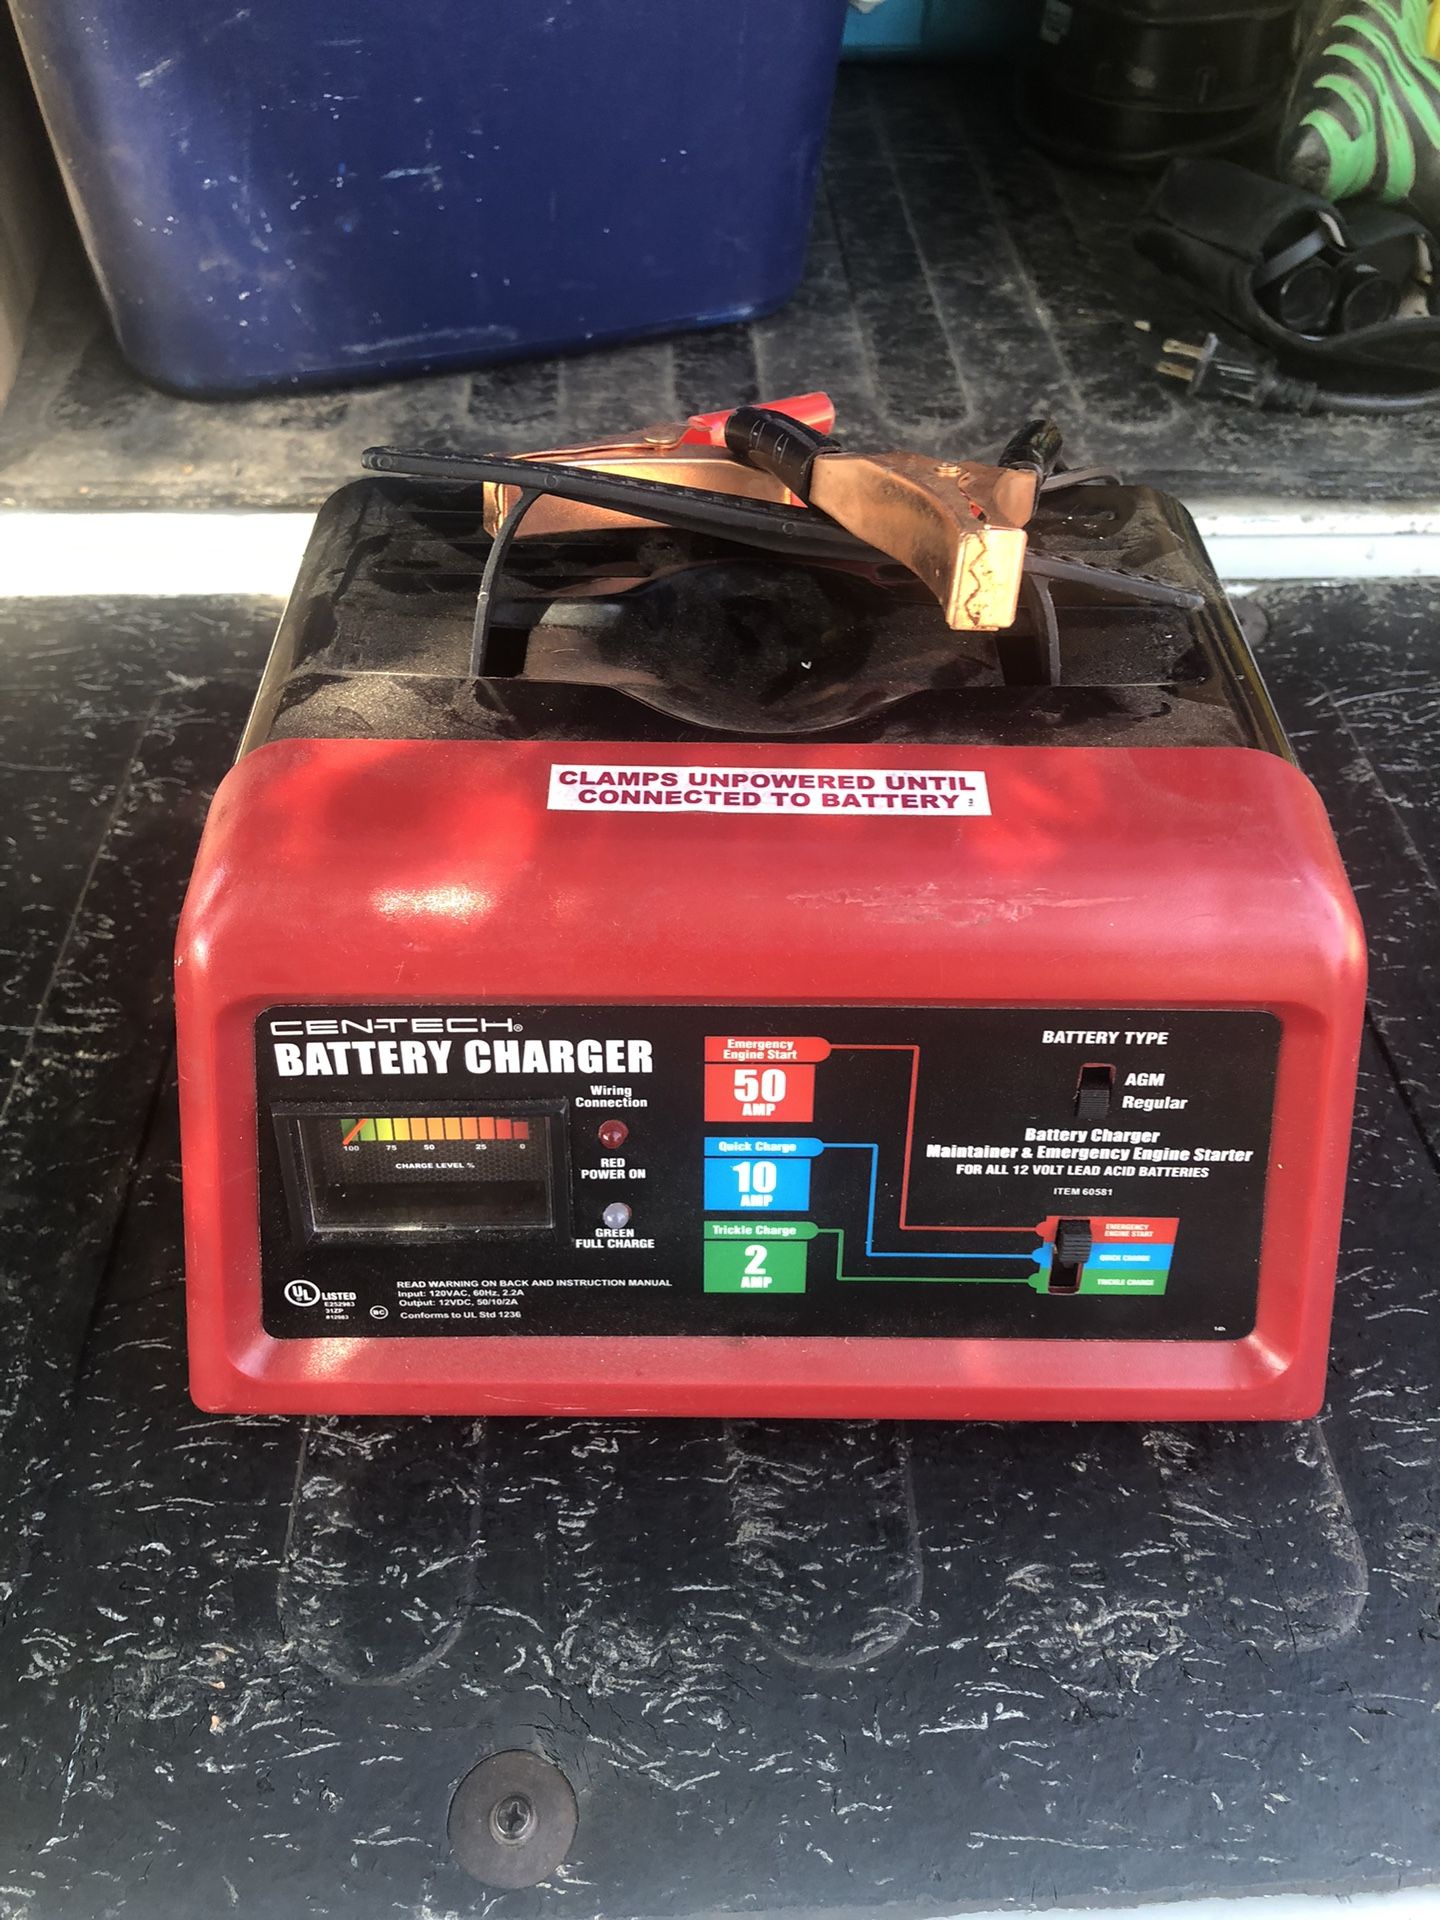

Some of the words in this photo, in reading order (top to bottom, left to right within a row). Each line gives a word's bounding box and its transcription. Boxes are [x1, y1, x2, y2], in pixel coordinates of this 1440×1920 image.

[558, 770, 678, 787] CLAMPS
[688, 772, 876, 790] UNPOWERED
[885, 775, 976, 791] UNTIL
[577, 789, 761, 806] CONNECTED
[769, 791, 811, 807] TO
[821, 793, 960, 809] BATTERY
[1042, 1030, 1120, 1044] BATTERY
[1124, 1032, 1169, 1045] TYPE
[727, 1039, 795, 1050] Emergency
[273, 1040, 453, 1077] BATTERY
[464, 1039, 654, 1075] CHARGER
[723, 1049, 764, 1061] Engine
[767, 1049, 798, 1060] Start
[733, 1068, 787, 1103] 50
[1124, 1073, 1165, 1086] AGM
[590, 1085, 632, 1097] Wiring
[575, 1097, 648, 1108] Connection
[1121, 1095, 1188, 1112] Regular
[742, 1103, 776, 1116] AMP
[1024, 1128, 1087, 1143] Battery
[1090, 1129, 1160, 1145] Charger
[718, 1141, 753, 1152] Quick
[755, 1141, 797, 1153] Charge
[926, 1144, 1019, 1159] Maintainer
[1021, 1147, 1034, 1159] &
[1036, 1146, 1130, 1162] Emergency
[1133, 1147, 1190, 1163] Engine
[1193, 1148, 1254, 1163] Starter
[600, 1158, 626, 1168] RED
[580, 1169, 626, 1180] POWER
[629, 1169, 646, 1179] ON
[731, 1161, 777, 1193] 10
[956, 1164, 983, 1175] FOR
[985, 1164, 1009, 1175] ALL
[1012, 1165, 1030, 1175] 12
[1032, 1165, 1064, 1176] VOLT
[1066, 1165, 1101, 1177] LEAD
[1103, 1166, 1136, 1177] ACID
[1138, 1166, 1210, 1178] BATTERIES
[1053, 1187, 1080, 1196] ITEM
[1082, 1188, 1113, 1196] 60581
[740, 1194, 774, 1207] AMP
[595, 1228, 635, 1237] GREEN
[712, 1225, 752, 1235] Trickle
[755, 1225, 797, 1237] Charge
[575, 1239, 604, 1248] FULL
[607, 1239, 655, 1248] CHARGE
[744, 1244, 768, 1275] 2
[397, 1280, 426, 1288] READ
[428, 1280, 479, 1288] WARNING
[499, 1279, 529, 1287] BACK
[532, 1279, 554, 1287] AND
[556, 1279, 626, 1287] INSTRUCTION
[628, 1279, 672, 1287] MANUAL
[740, 1276, 773, 1288] AMP
[292, 1285, 313, 1301] UL
[321, 1292, 357, 1300] LISTED
[398, 1290, 426, 1299] Input:
[502, 1289, 525, 1297] 2.2A
[399, 1299, 436, 1308] Output:
[400, 1311, 449, 1319] Conforms
